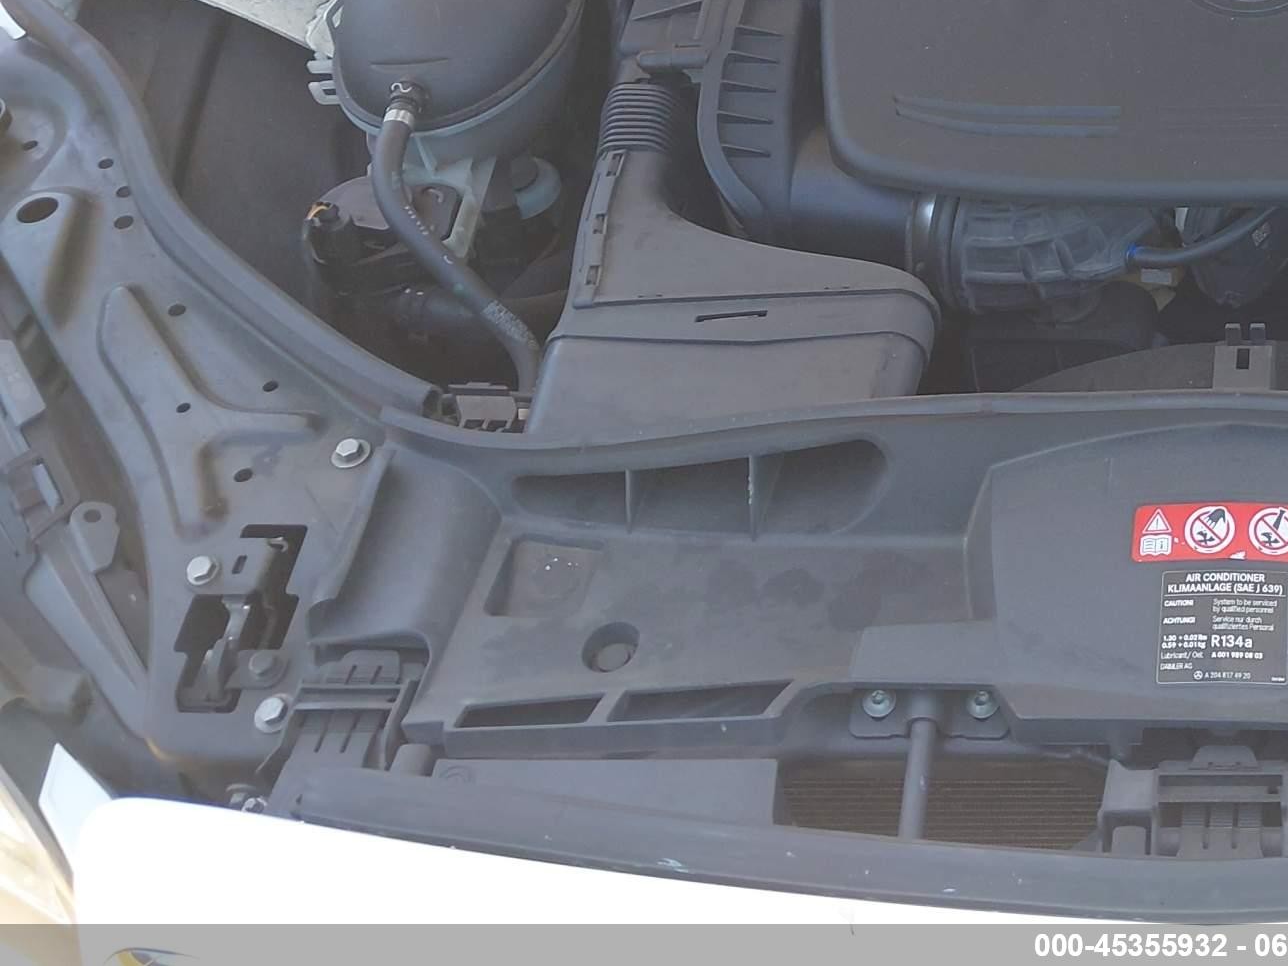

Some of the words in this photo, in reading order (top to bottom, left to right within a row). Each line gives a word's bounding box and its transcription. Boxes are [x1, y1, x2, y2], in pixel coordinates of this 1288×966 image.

[1186, 573, 1201, 582] AIR
[1203, 573, 1265, 583] CONDITIONER
[1168, 584, 1232, 593] KLIMAANLAGE
[1233, 584, 1255, 595] (SAE
[1256, 584, 1261, 594] J
[1262, 585, 1283, 595] 639)
[1212, 598, 1235, 607] System
[1253, 599, 1278, 607] serviced
[1212, 606, 1220, 614] by
[1221, 606, 1245, 614] qualified
[1212, 616, 1234, 624] Service
[1246, 616, 1262, 624] durch
[1211, 635, 1253, 649] R134a
